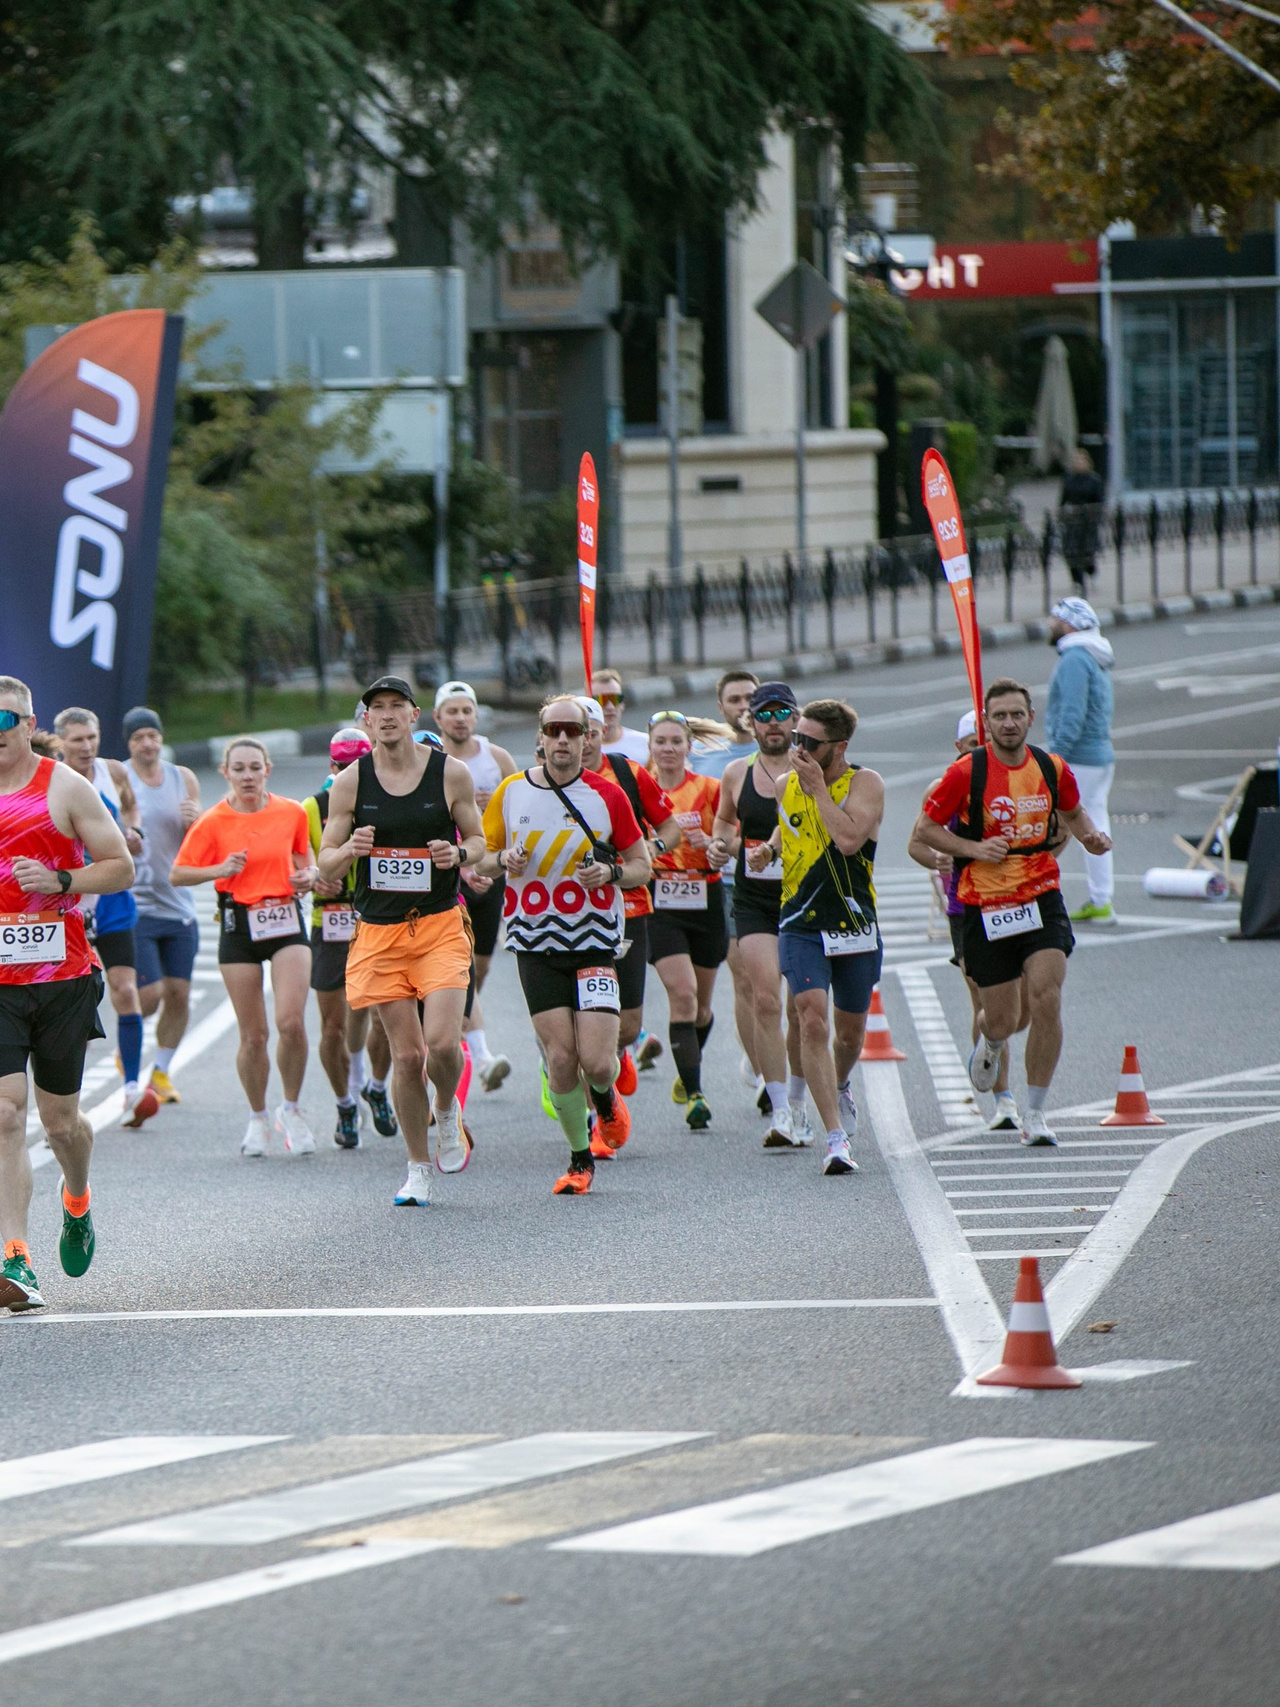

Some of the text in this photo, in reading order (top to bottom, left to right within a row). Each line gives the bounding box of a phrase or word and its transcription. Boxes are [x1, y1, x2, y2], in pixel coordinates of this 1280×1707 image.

[1001, 821, 1045, 839] 3:29
[378, 859, 424, 875] 6329
[661, 881, 700, 895] 6725
[257, 905, 293, 924] 6421
[2, 924, 57, 945] 6387
